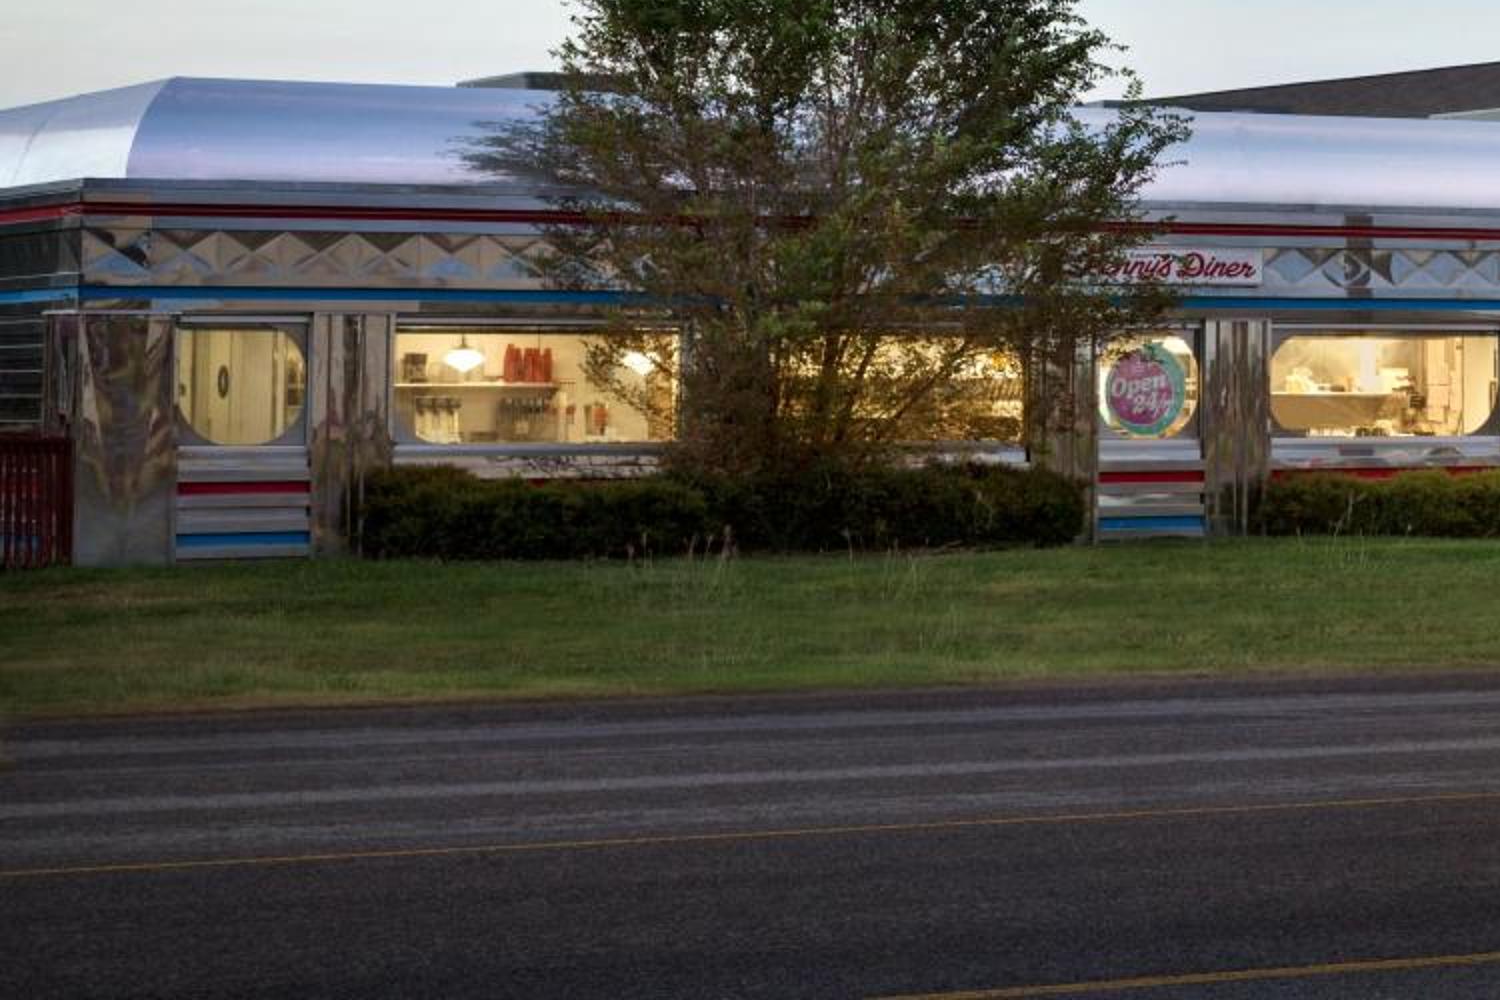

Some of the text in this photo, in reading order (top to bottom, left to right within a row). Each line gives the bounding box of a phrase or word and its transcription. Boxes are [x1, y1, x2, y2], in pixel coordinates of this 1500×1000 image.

[1087, 251, 1256, 280] enny's Diner
[1111, 374, 1168, 400] Open
